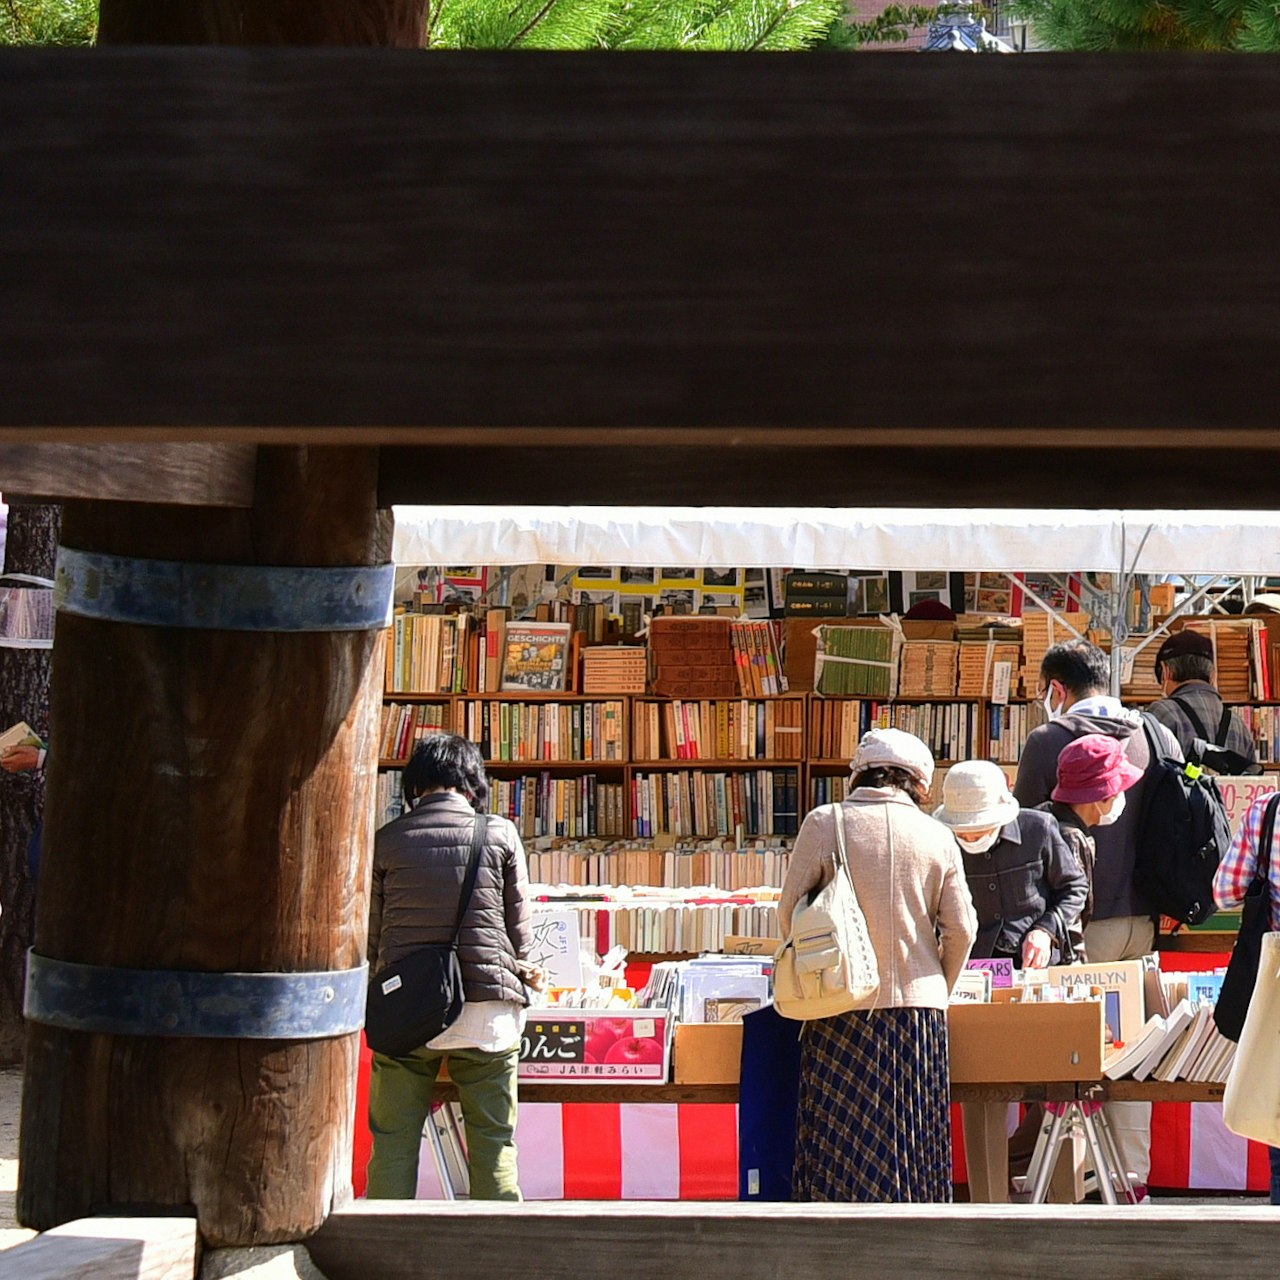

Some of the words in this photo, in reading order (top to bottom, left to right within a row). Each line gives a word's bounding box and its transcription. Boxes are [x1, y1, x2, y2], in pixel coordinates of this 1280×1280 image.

[1060, 971, 1126, 985] MARILYN
[520, 1035, 581, 1060] りんご
